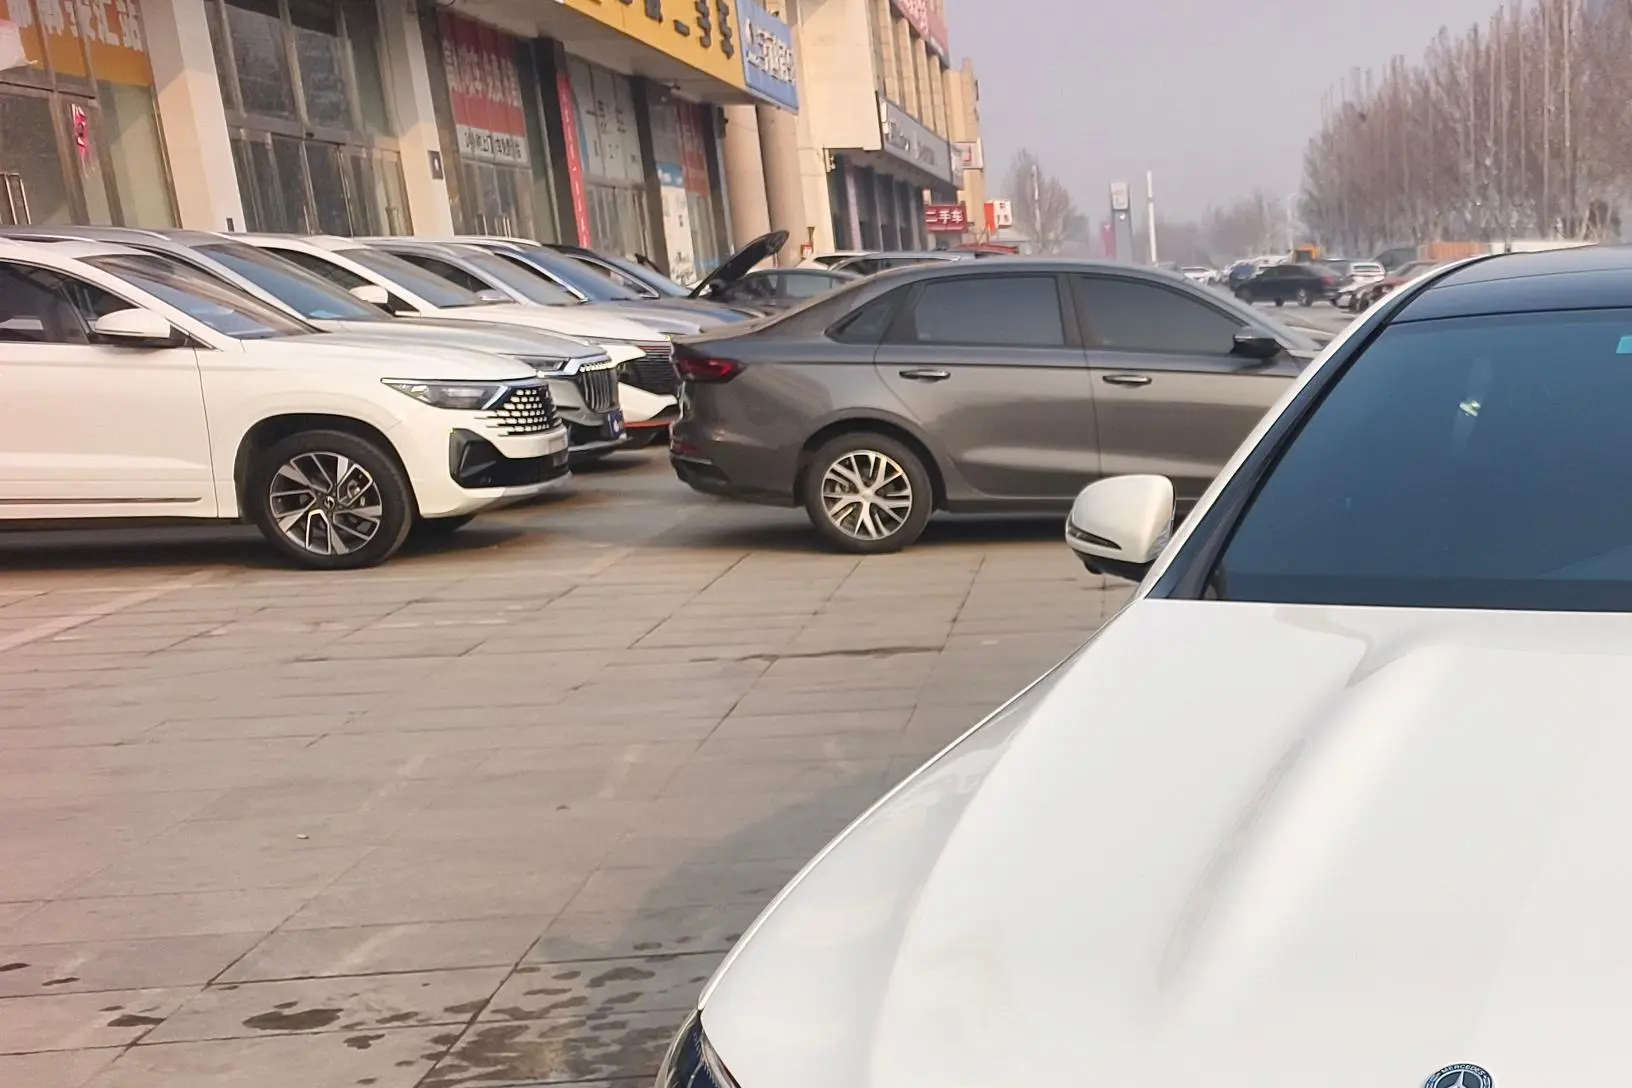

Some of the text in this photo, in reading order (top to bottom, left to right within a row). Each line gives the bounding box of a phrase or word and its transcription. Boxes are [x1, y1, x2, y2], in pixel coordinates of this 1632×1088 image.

[925, 208, 963, 224] 二手车
[1441, 1064, 1486, 1076] MERCEDES
